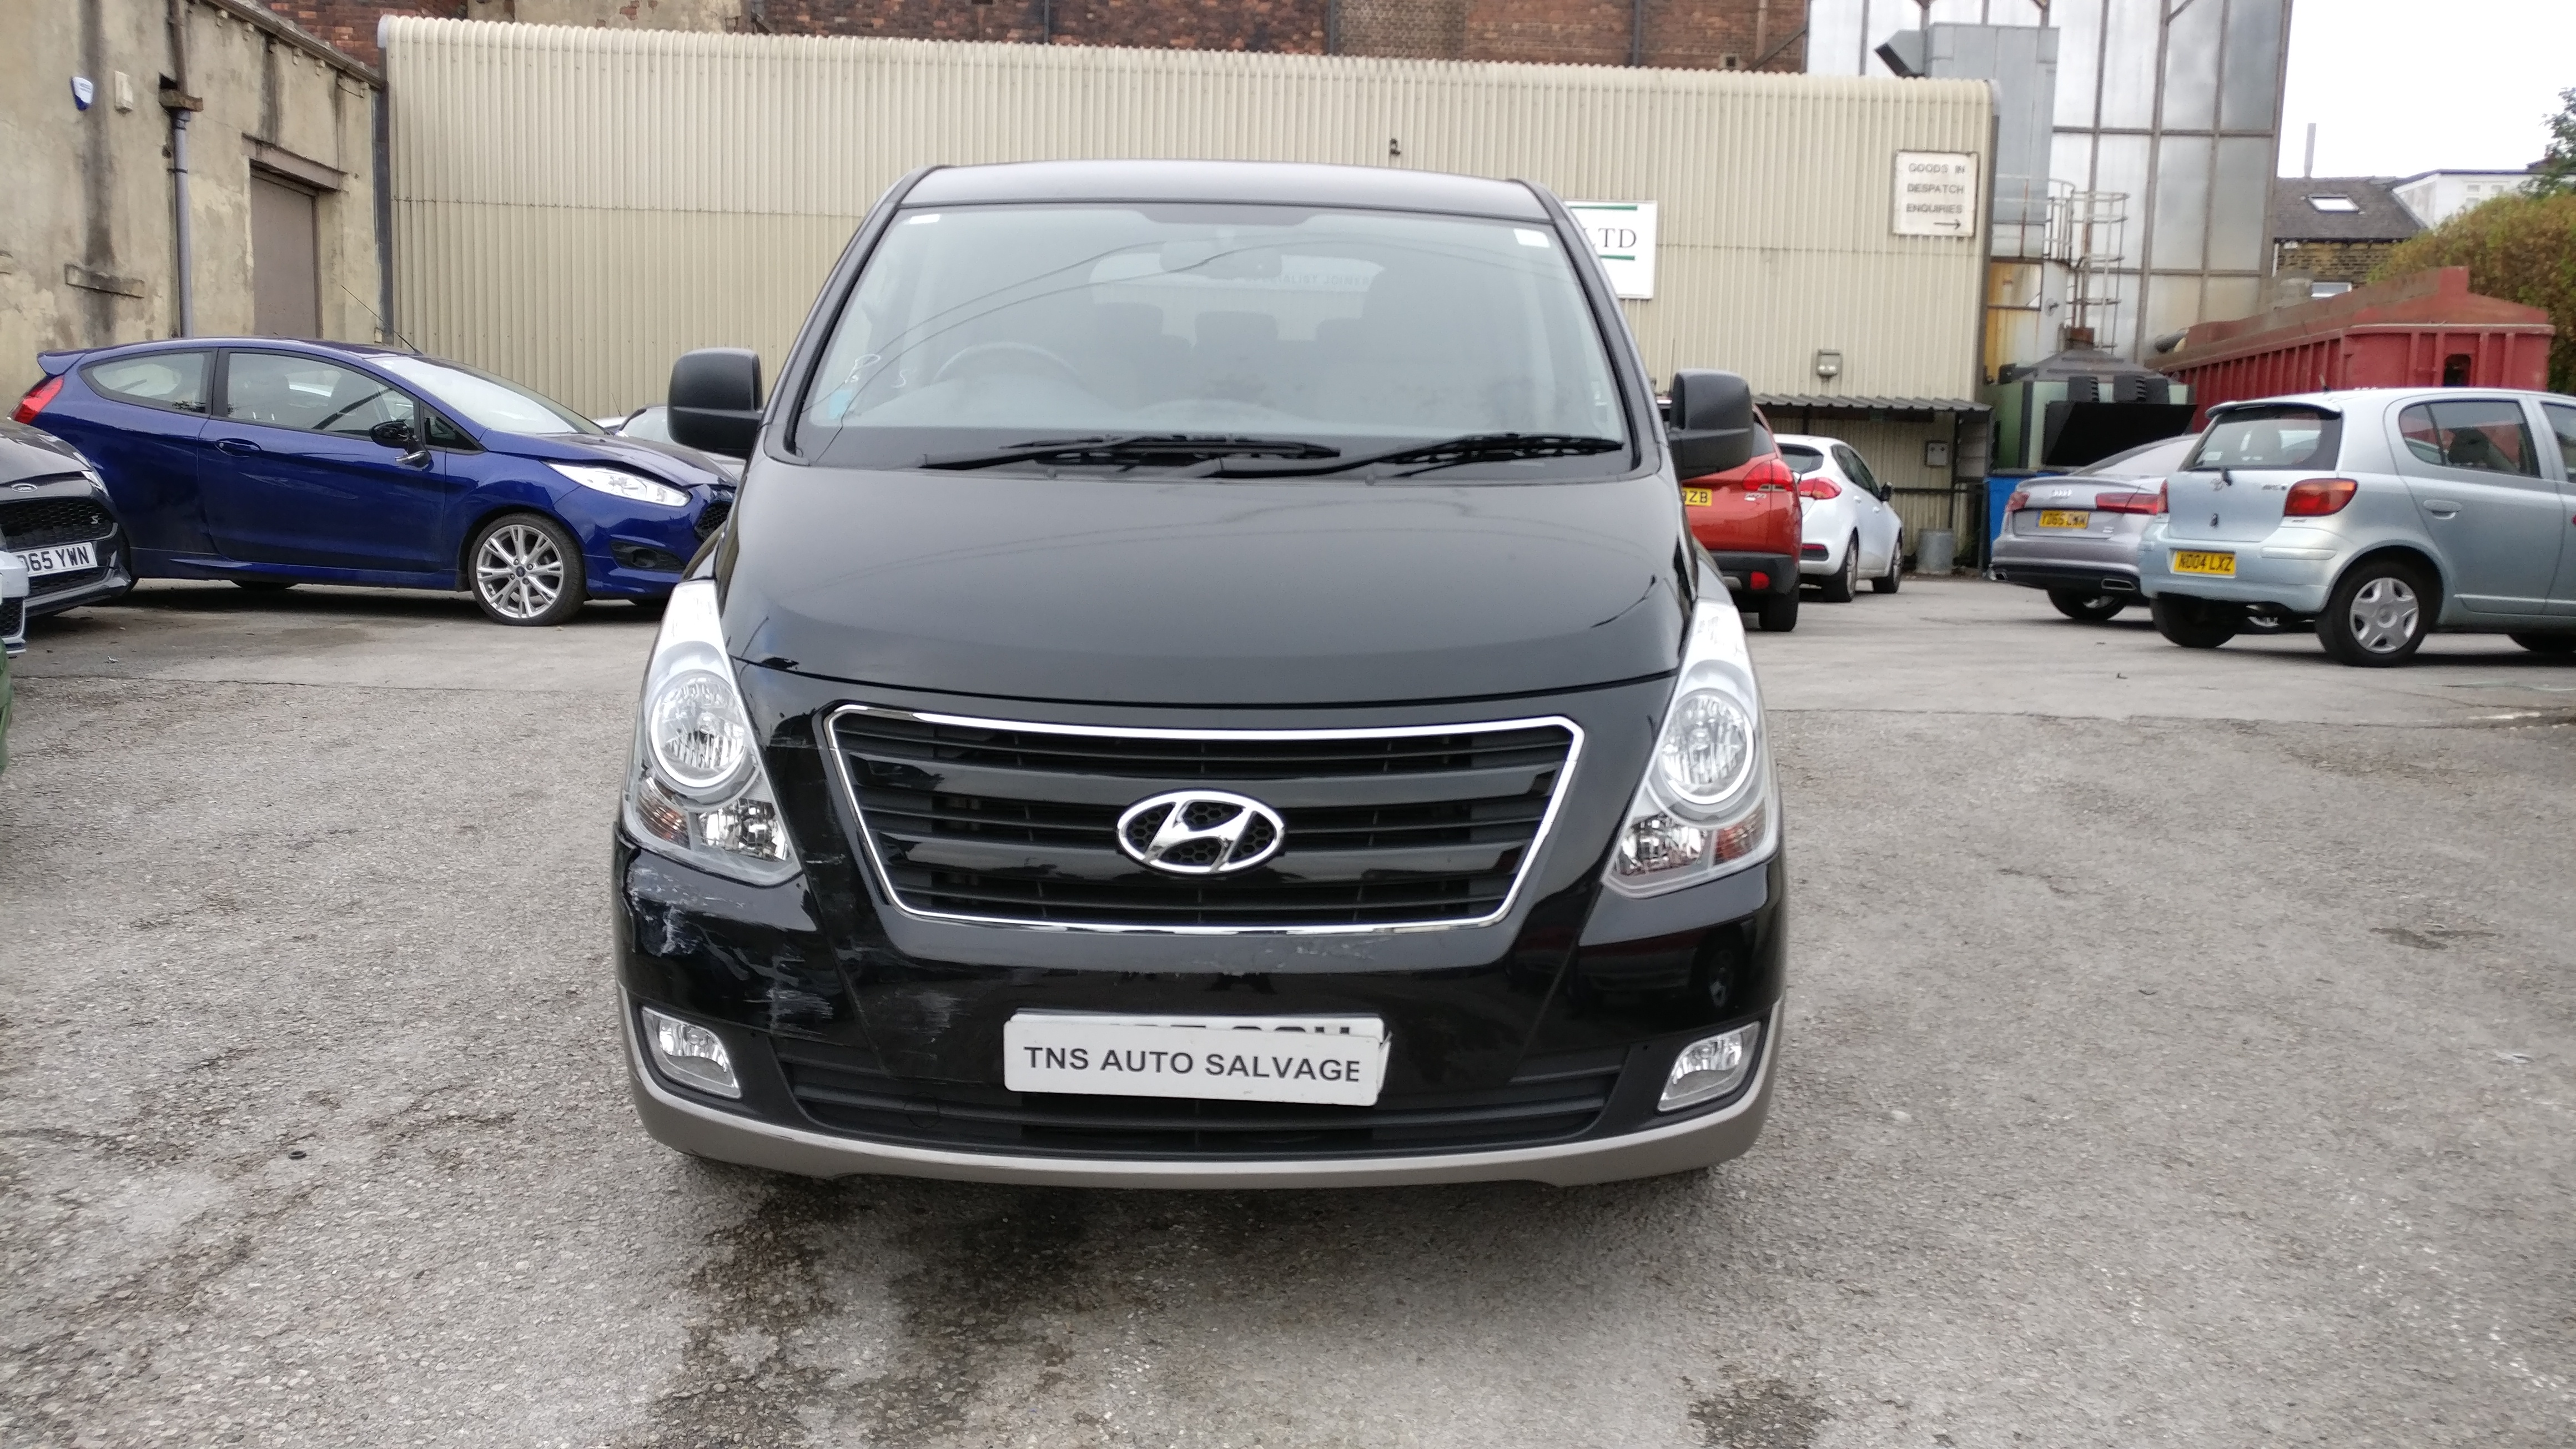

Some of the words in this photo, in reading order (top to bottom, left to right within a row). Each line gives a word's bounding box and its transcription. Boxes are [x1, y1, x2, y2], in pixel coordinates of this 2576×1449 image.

[1908, 163, 1949, 174] GOODS
[1954, 165, 1965, 174] IN
[1906, 183, 1965, 194] DESPATCH
[1906, 203, 1963, 214] ENQUIRIES
[56, 546, 89, 567] YWN
[2209, 554, 2233, 571] LXZ
[1023, 1046, 1089, 1070] TNS
[1099, 1049, 1194, 1074] AUTO
[1205, 1053, 1360, 1082] SALVAGE
